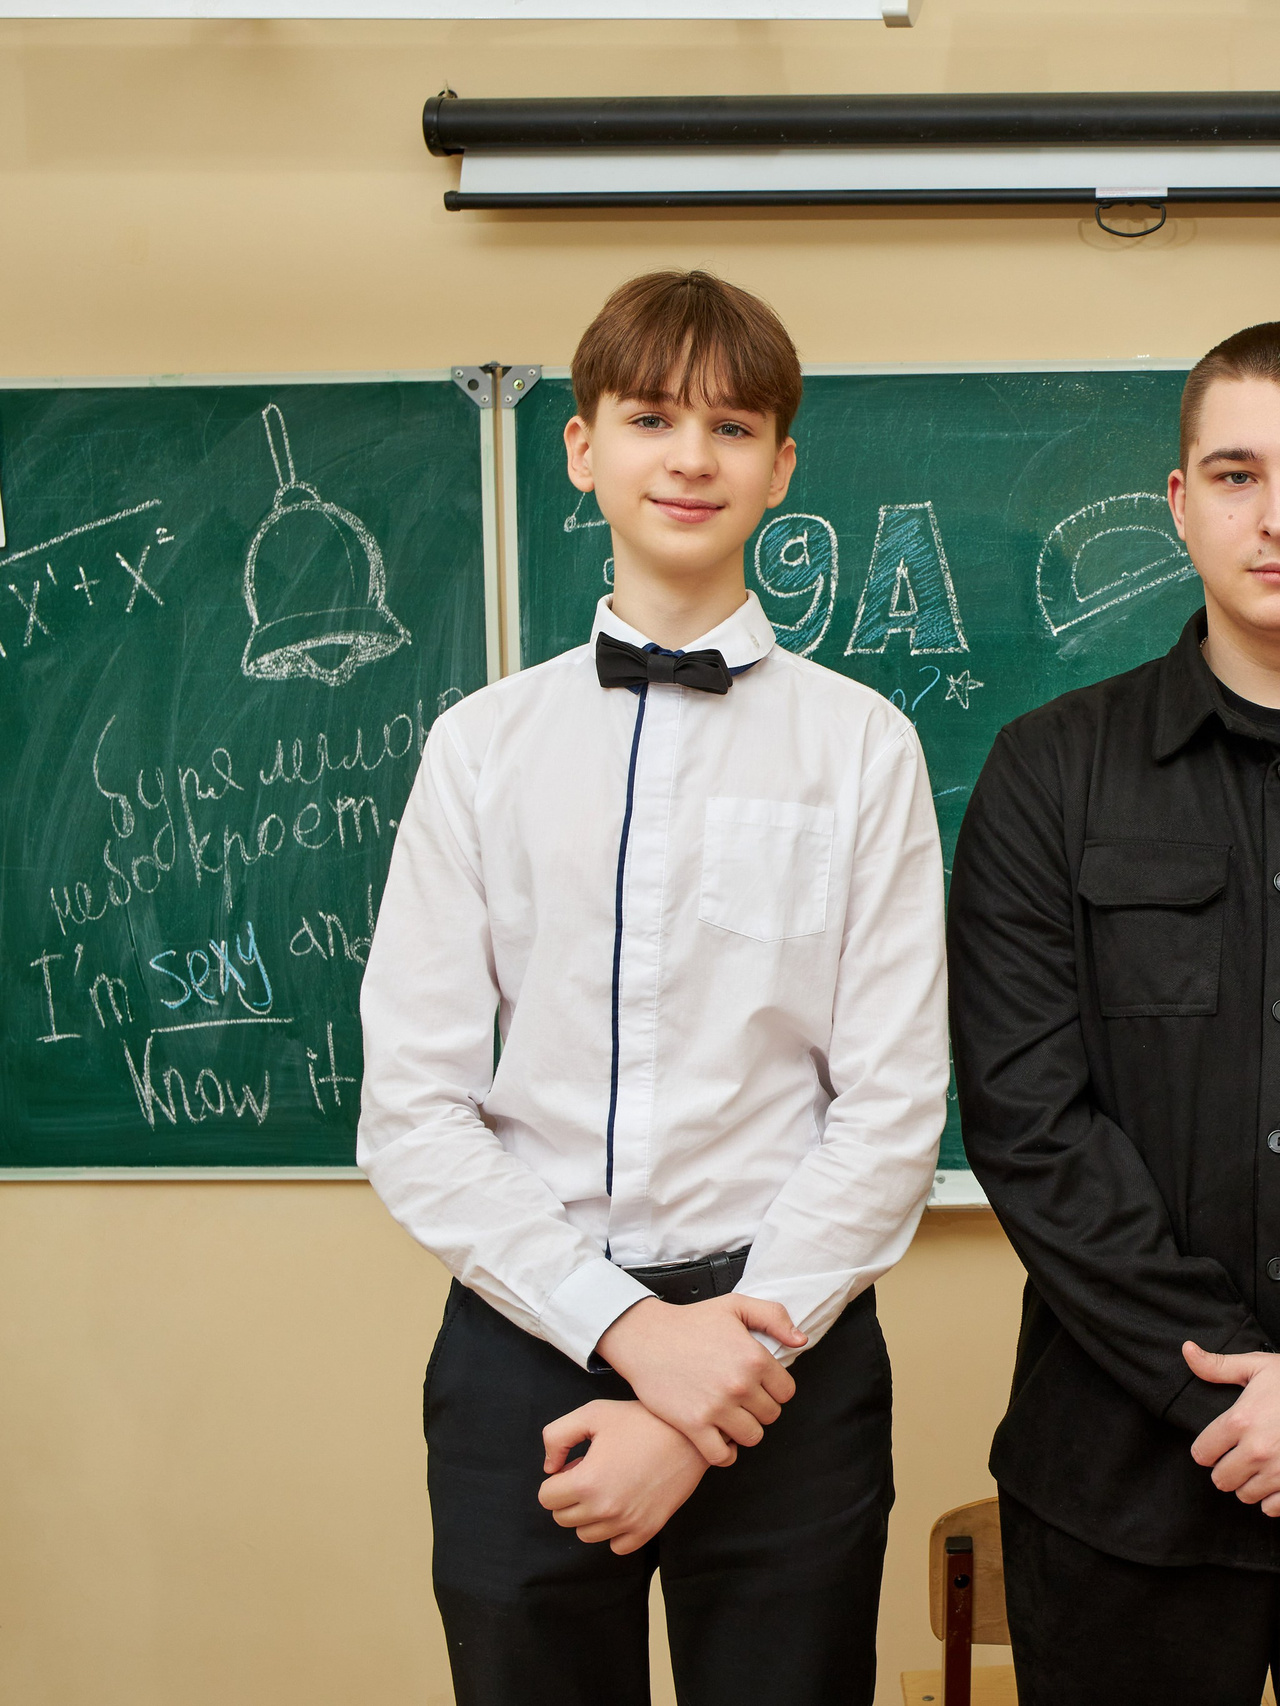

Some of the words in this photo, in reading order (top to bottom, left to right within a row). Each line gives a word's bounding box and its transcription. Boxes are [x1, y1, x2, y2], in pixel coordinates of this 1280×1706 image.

[30, 943, 135, 1043] I'm
[149, 920, 273, 1015] sexy
[306, 1021, 357, 1114] it
